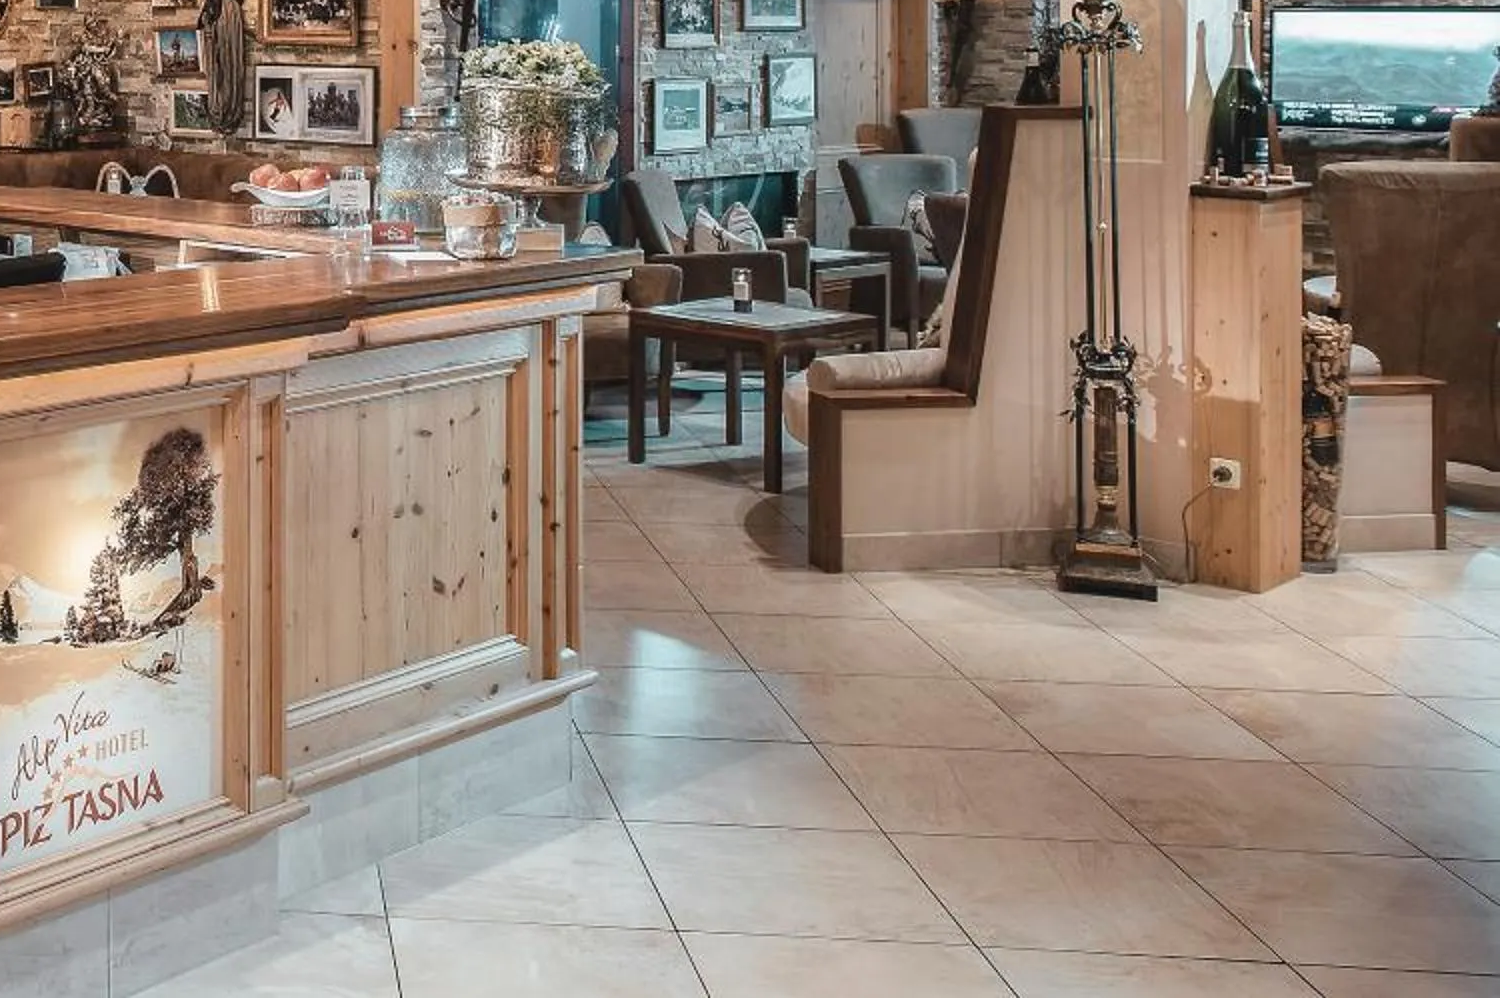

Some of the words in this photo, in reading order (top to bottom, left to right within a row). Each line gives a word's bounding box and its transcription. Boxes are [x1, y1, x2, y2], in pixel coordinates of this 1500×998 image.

[11, 734, 60, 801] Alp
[53, 690, 111, 743] Vita
[95, 727, 150, 762] HOTEL
[62, 766, 165, 835] TASNA
